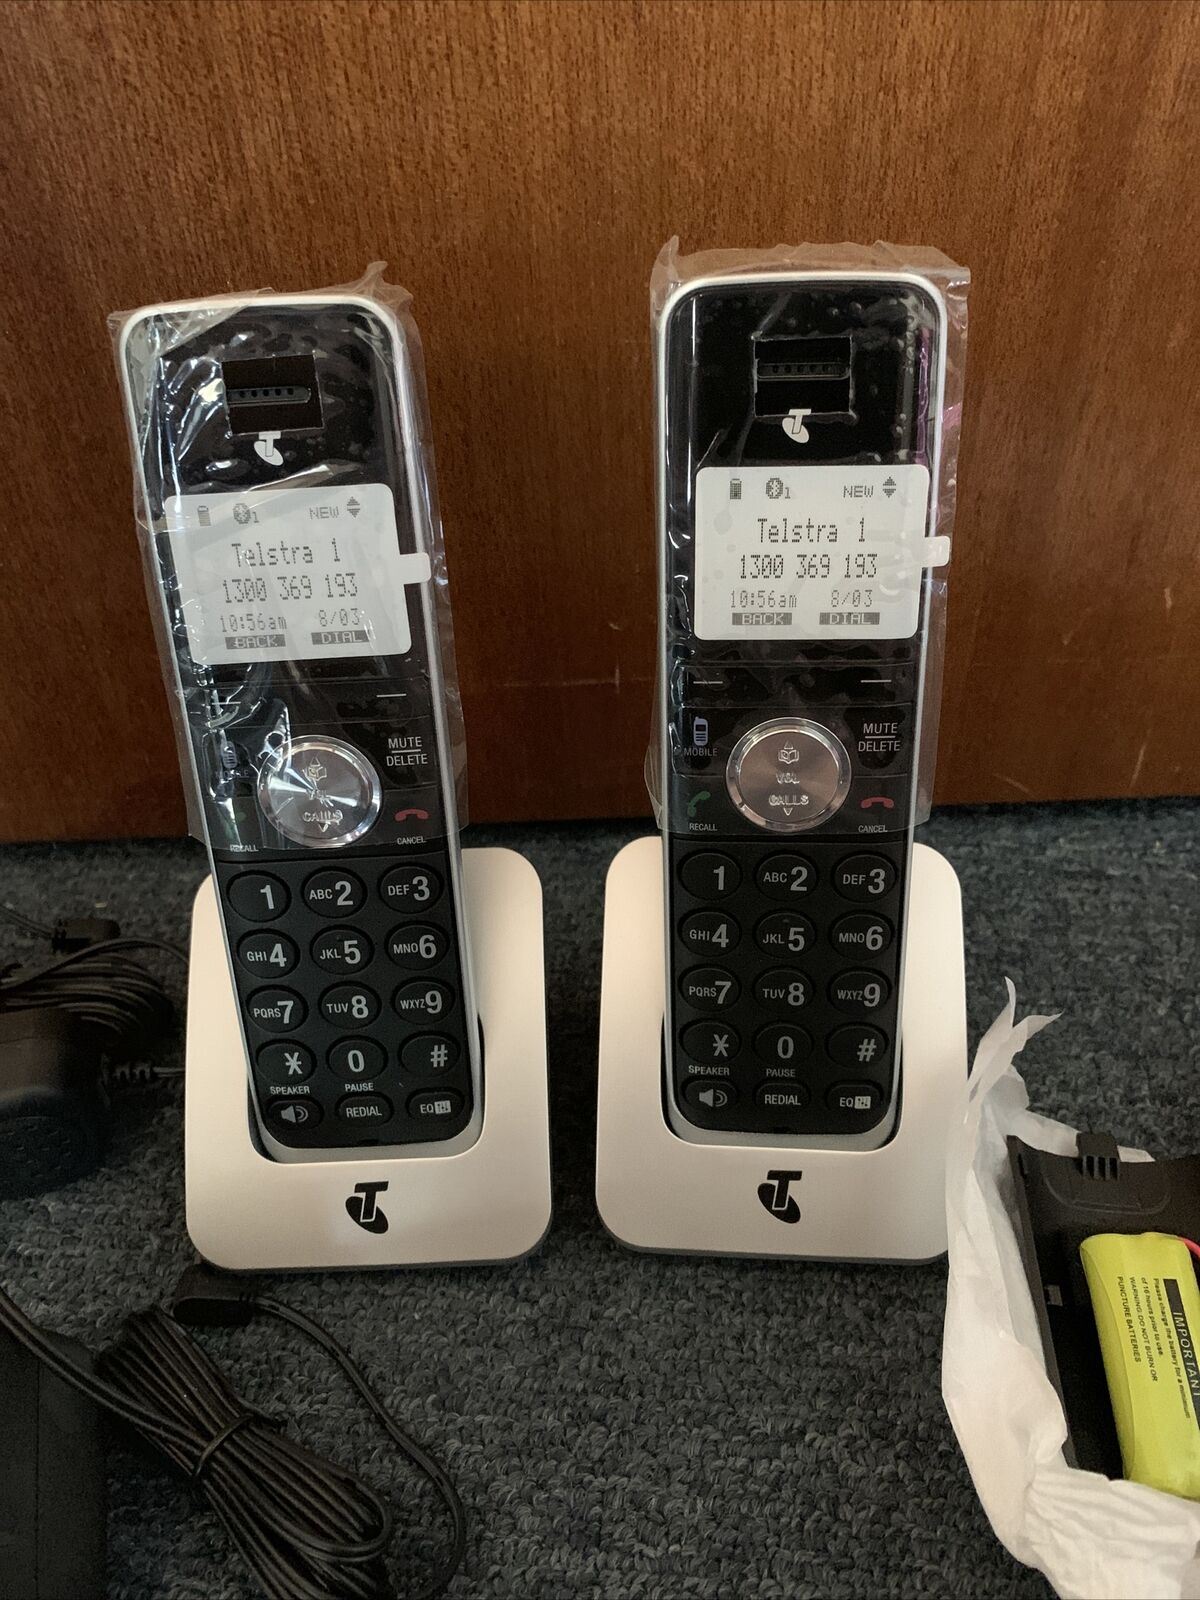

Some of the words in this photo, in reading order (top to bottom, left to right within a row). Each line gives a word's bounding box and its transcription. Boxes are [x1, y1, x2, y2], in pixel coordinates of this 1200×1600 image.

[784, 487, 791, 499] 1
[843, 485, 874, 498] NEW
[252, 511, 260, 523] 1
[309, 506, 339, 520] NEW
[757, 518, 838, 543] Telstra
[859, 517, 866, 542] 1
[231, 541, 313, 567] Telstra
[332, 538, 340, 562] 1
[740, 554, 783, 579] 1300
[796, 554, 830, 578] 369
[844, 554, 878, 578] 193
[223, 577, 267, 603] 1300
[277, 575, 312, 600] 369
[325, 572, 358, 598] 193
[731, 590, 798, 608] 10:56am
[831, 589, 873, 607] 8/03
[220, 613, 287, 633] 10:56am
[318, 608, 360, 627] 8/03
[742, 614, 784, 625] BACK
[829, 614, 871, 625] DIAL
[234, 635, 279, 649] BACK
[321, 631, 362, 644] DIAL
[863, 722, 898, 734] MUTE
[388, 736, 423, 749] MUTE
[858, 741, 900, 752] DELETE
[386, 754, 428, 766] DELETE
[684, 748, 718, 757] MOBILE
[776, 772, 800, 784] VOL
[769, 794, 809, 806] CALLS
[689, 823, 718, 831] RECALL
[858, 824, 888, 833] CANCEL
[230, 844, 259, 852] RECALL
[397, 836, 426, 845] CANCEL
[713, 866, 725, 891] 1
[763, 872, 788, 883] ABC
[790, 866, 808, 891] 2
[842, 874, 866, 885] DEF
[868, 868, 886, 894] 3
[309, 888, 333, 899] ABC
[335, 881, 354, 906] 2
[388, 884, 410, 896] DEF
[412, 875, 430, 901] 3
[261, 884, 275, 909] 1
[689, 929, 710, 941] GHI
[711, 924, 729, 948] 4
[763, 933, 785, 944] JKL
[788, 927, 805, 952] 5
[839, 933, 865, 943] MNO
[865, 925, 883, 950] 6
[319, 948, 341, 960] JKL
[343, 940, 361, 964] 5
[393, 943, 419, 954] MNO
[419, 934, 437, 959] 6
[247, 950, 267, 962] GHI
[269, 943, 287, 967] 4
[689, 986, 717, 998] PQRS
[714, 981, 732, 1004] 7
[763, 988, 785, 999] TUV
[787, 982, 805, 1006] 8
[837, 989, 863, 1001] WXYZ
[863, 983, 881, 1007] 9
[326, 1003, 349, 1014] TUV
[351, 995, 369, 1019] 8
[400, 998, 425, 1010] WXYZ
[425, 990, 443, 1014] 9
[254, 1007, 281, 1019] PQRS
[277, 1000, 294, 1024] 7
[777, 1036, 795, 1059] 0
[348, 1050, 365, 1073] 0
[688, 1065, 730, 1076] SPEAKER
[766, 1068, 796, 1078] PAUSE
[270, 1085, 310, 1095] SPEAKER
[345, 1082, 374, 1092] PAUSE
[764, 1094, 802, 1106] REDIAL
[840, 1097, 854, 1108] EQ
[346, 1106, 382, 1118] REDIAL
[420, 1103, 434, 1114] EQ
[1141, 1277, 1148, 1285] of
[1129, 1276, 1142, 1313] WARNING
[1143, 1286, 1150, 1294] 16
[1117, 1276, 1131, 1318] PUNCTURE
[1126, 1319, 1141, 1362] BATTERIES
[1138, 1315, 1145, 1327] DO
[1149, 1315, 1158, 1333] prior
[1153, 1278, 1162, 1301] Please
[1159, 1303, 1169, 1326] charge
[1169, 1341, 1178, 1366] battery
[1141, 1328, 1150, 1344] NOT
[1154, 1333, 1159, 1341] to
[1145, 1345, 1155, 1368] BURN
[1151, 1369, 1158, 1381] OR
